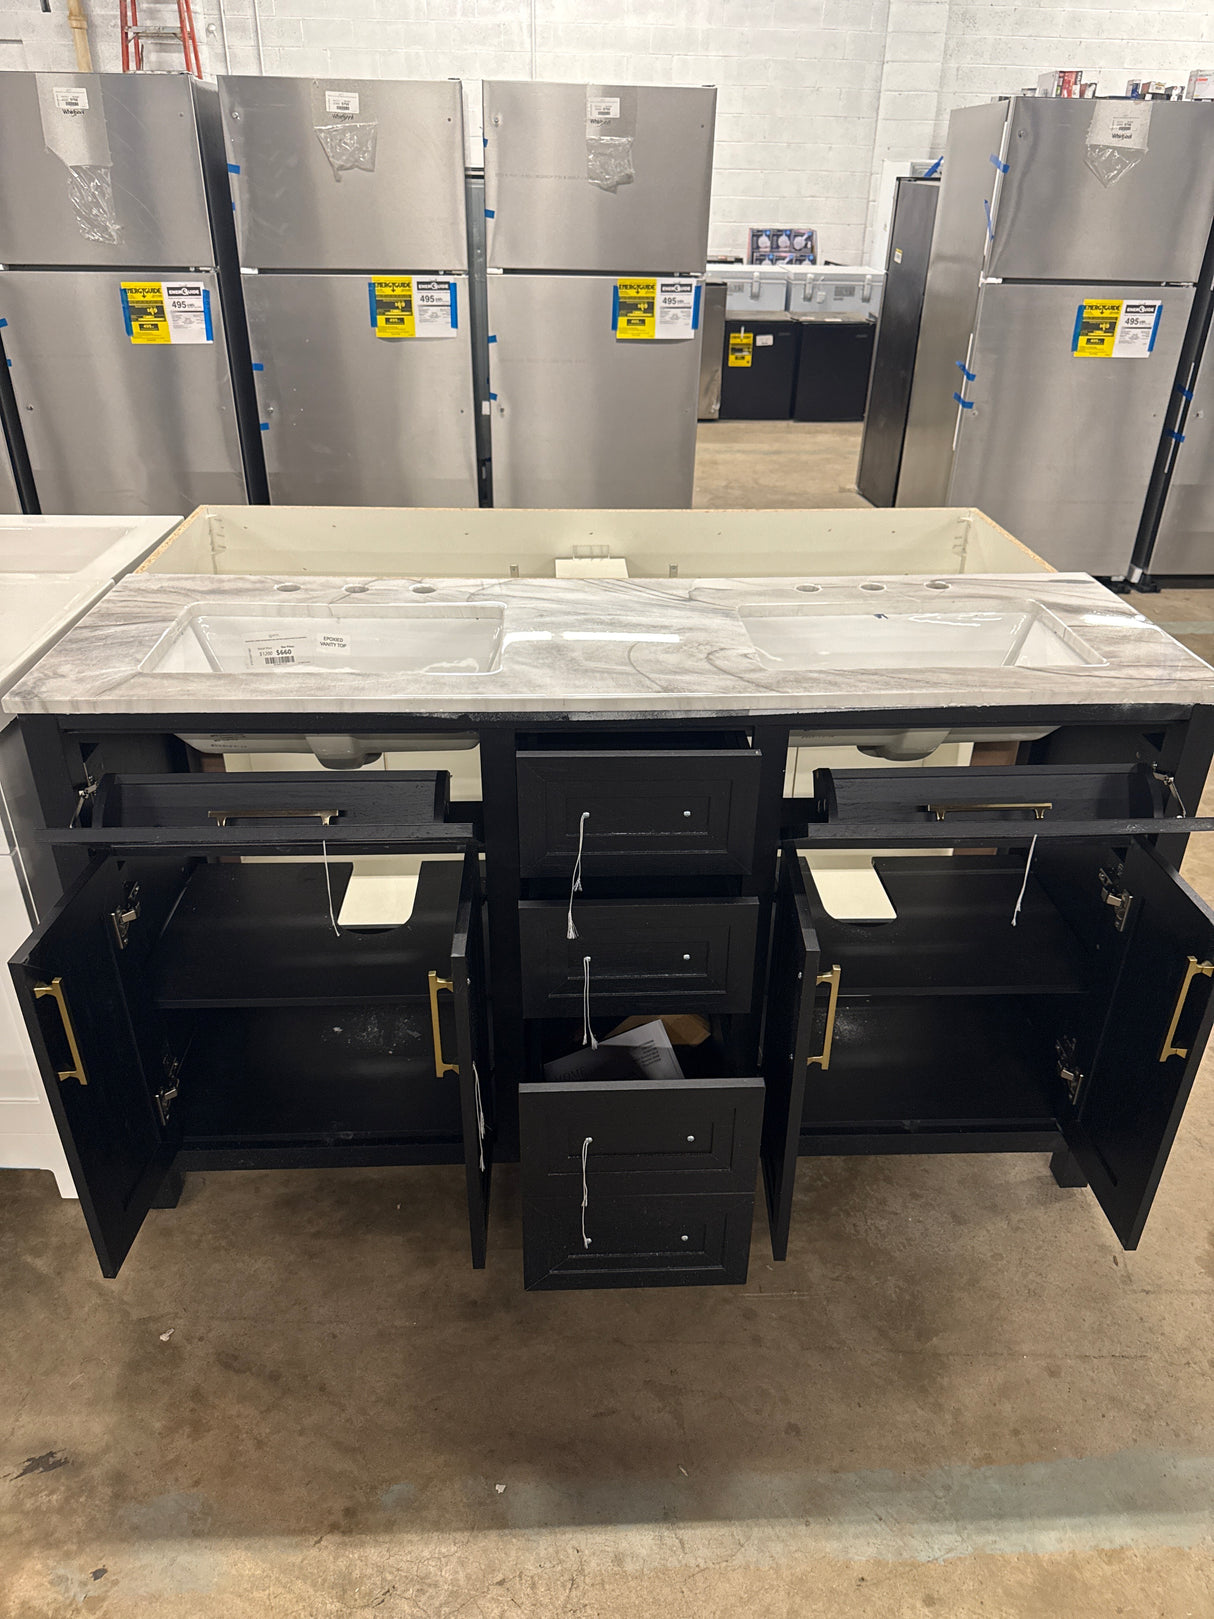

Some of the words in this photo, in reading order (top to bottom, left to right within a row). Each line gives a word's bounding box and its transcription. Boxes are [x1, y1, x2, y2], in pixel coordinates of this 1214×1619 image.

[420, 294, 435, 303] 495
[662, 297, 677, 305] 495
[171, 300, 187, 309] 495
[1125, 317, 1139, 325] 495
[276, 648, 292, 656] $660
